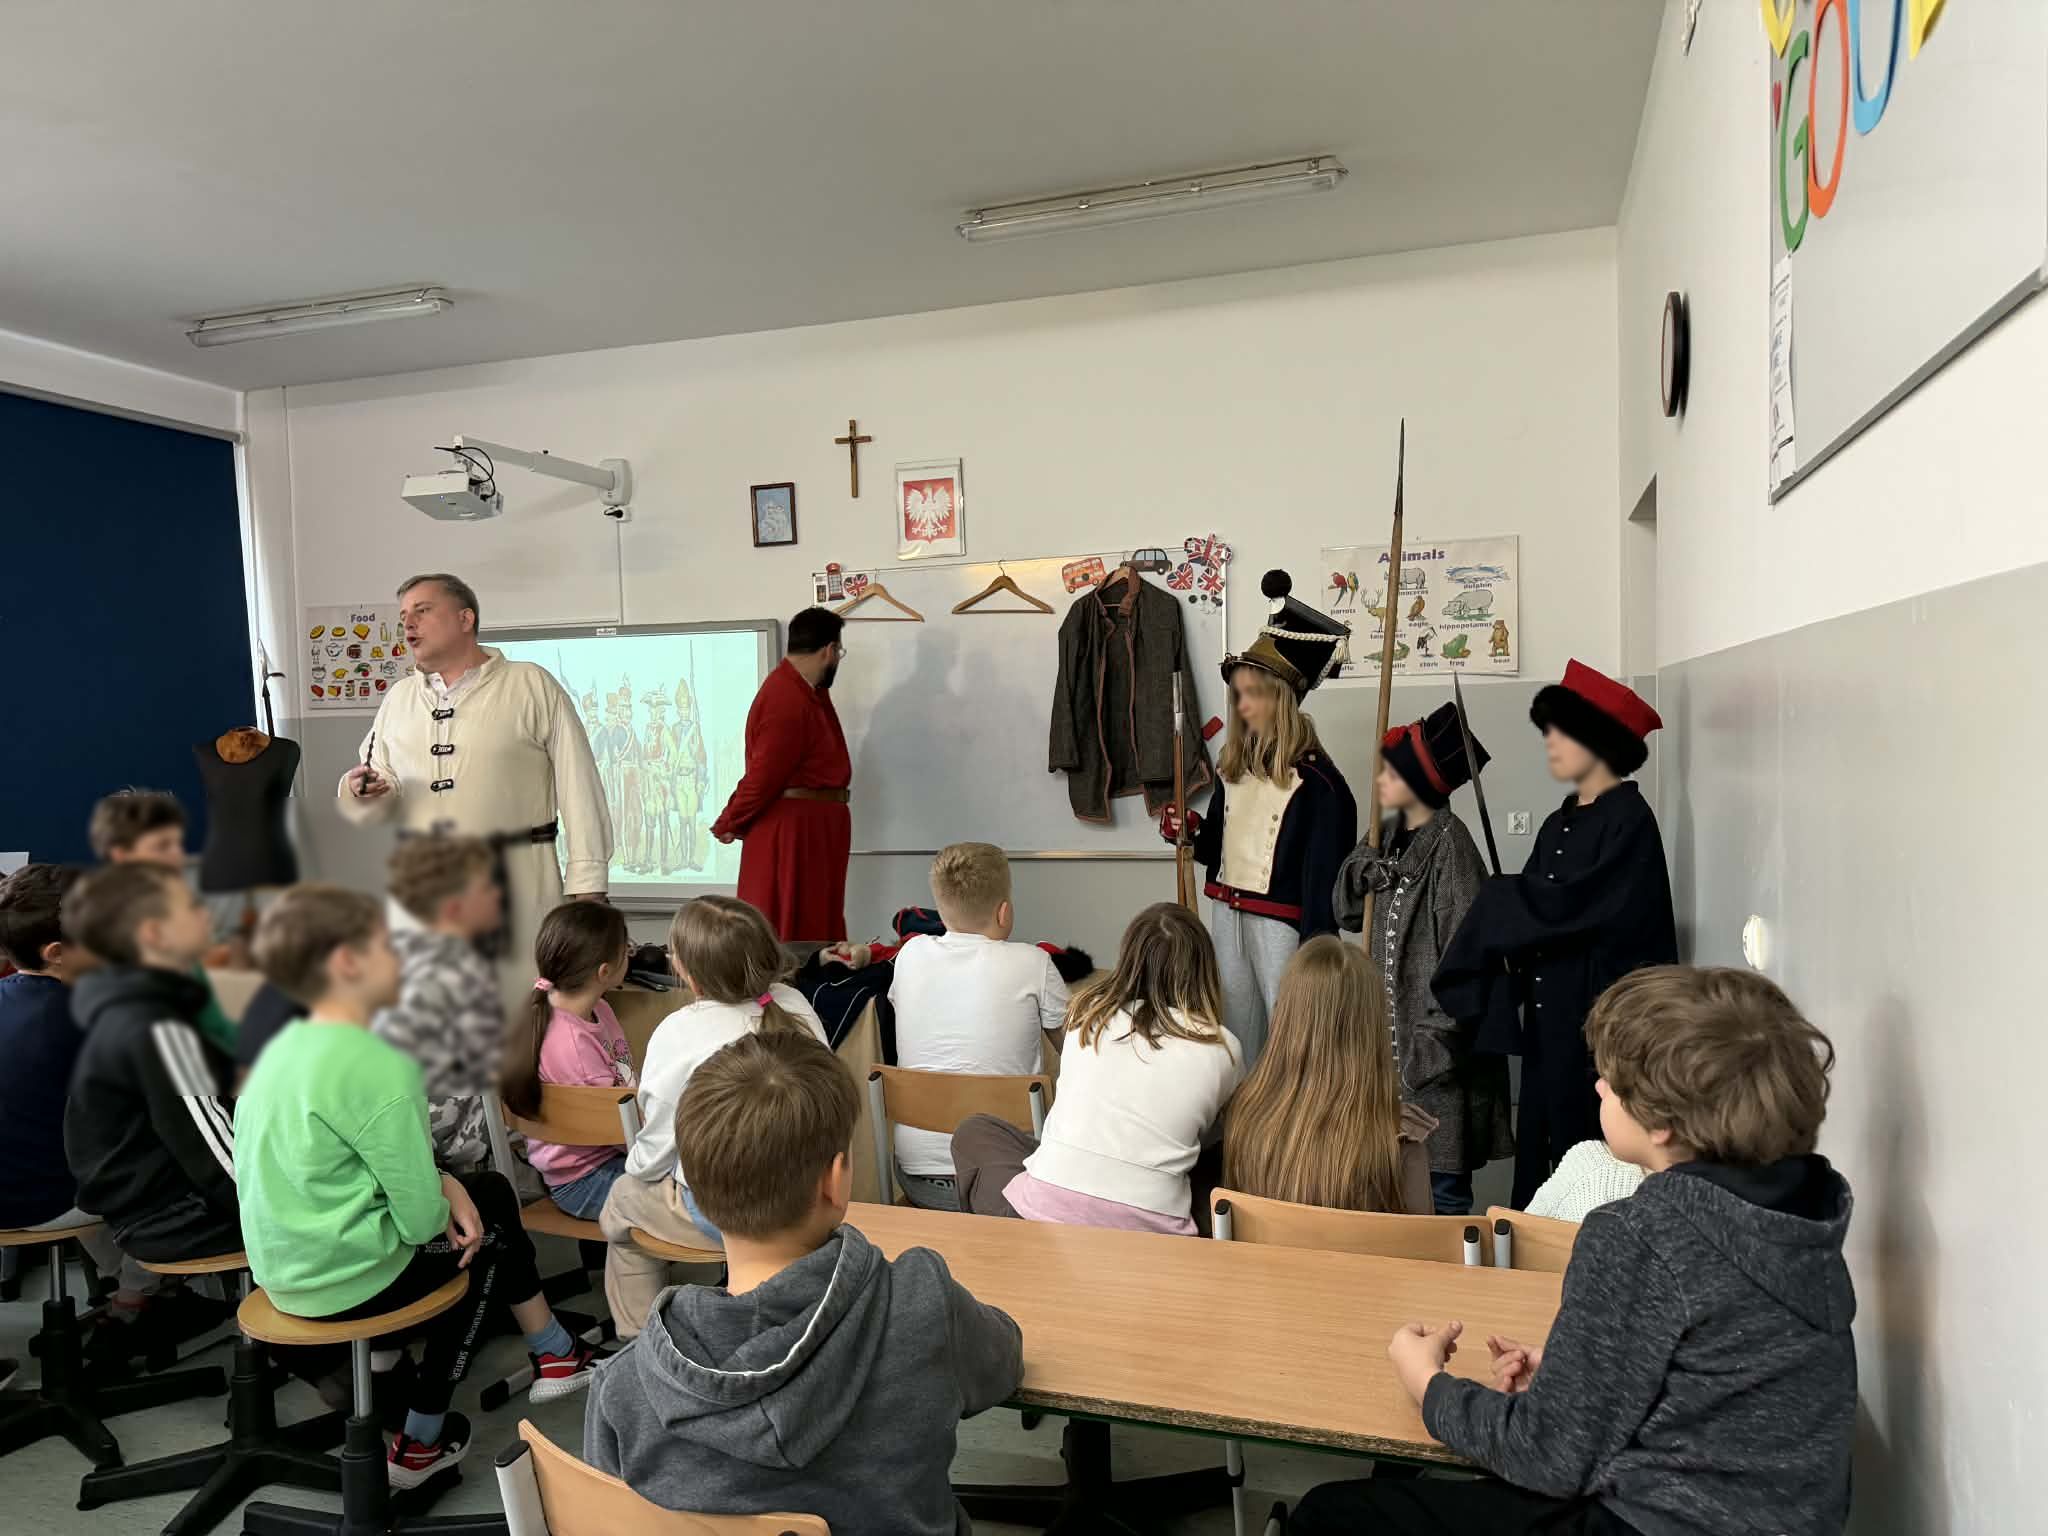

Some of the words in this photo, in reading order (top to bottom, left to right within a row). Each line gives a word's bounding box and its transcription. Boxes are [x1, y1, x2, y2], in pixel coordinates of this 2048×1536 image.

[1377, 549, 1445, 564] Aimals
[1330, 608, 1356, 616] parrots
[350, 613, 375, 622] Food
[1439, 621, 1492, 631] hippopotamus
